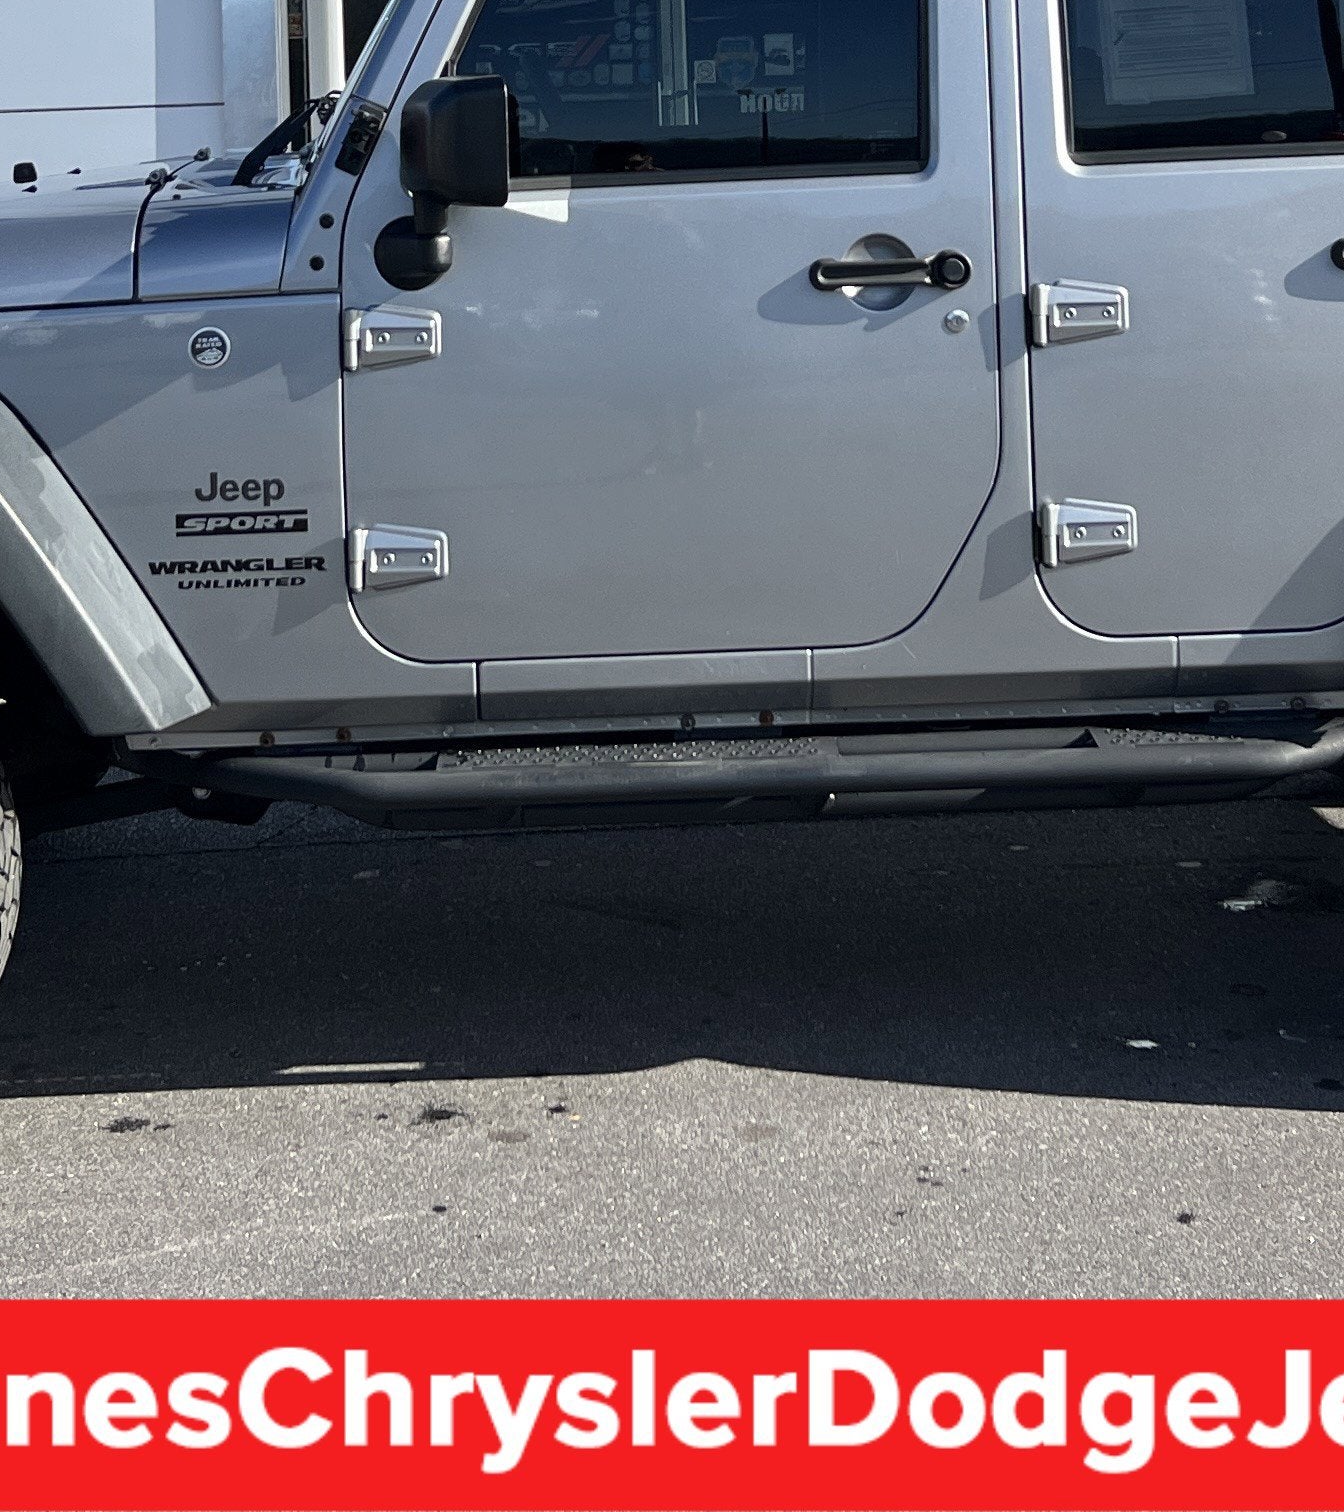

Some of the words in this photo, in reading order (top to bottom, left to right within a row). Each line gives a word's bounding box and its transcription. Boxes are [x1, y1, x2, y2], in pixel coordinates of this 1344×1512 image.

[195, 472, 285, 507] Jeep
[179, 514, 308, 533] SPORT
[148, 556, 327, 576] WRANGLER
[177, 576, 306, 591] UNLIMITED
